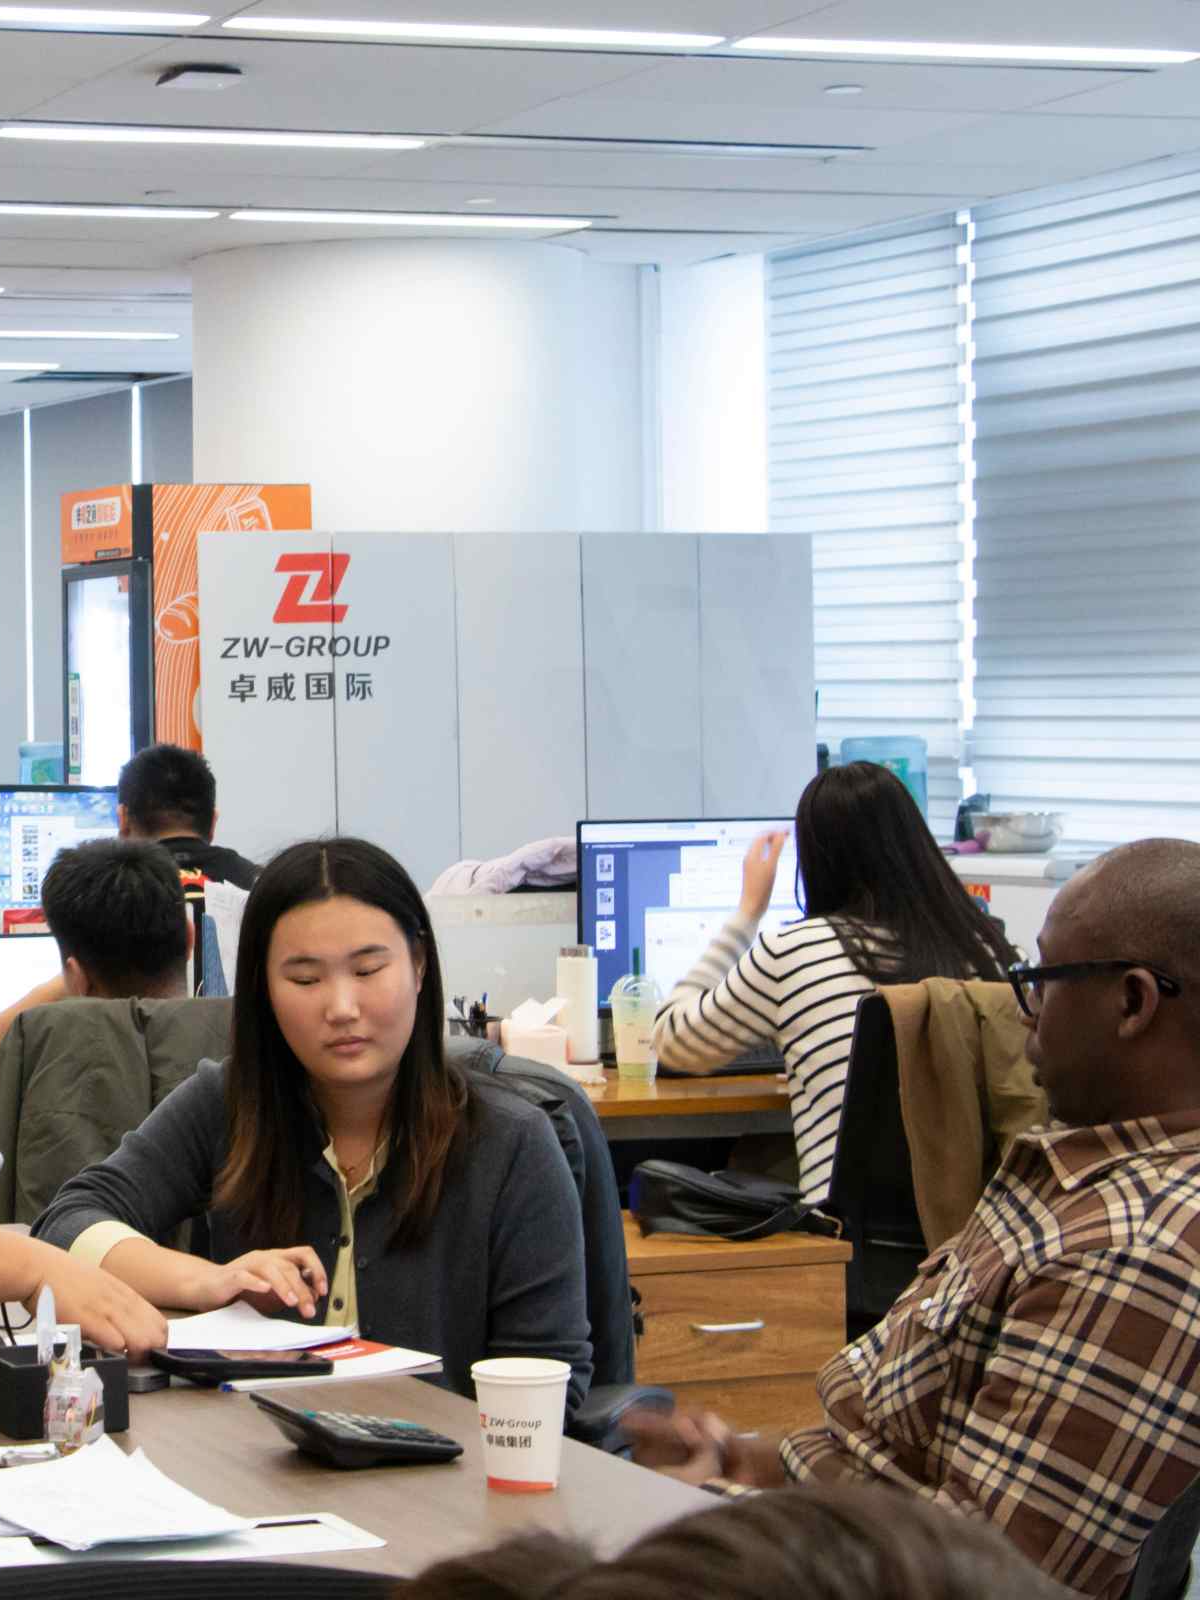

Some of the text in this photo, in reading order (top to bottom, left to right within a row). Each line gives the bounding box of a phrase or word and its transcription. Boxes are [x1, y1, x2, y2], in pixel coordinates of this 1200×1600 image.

[220, 635, 391, 659] ZW-GROUP
[228, 672, 373, 703] 卓威国际
